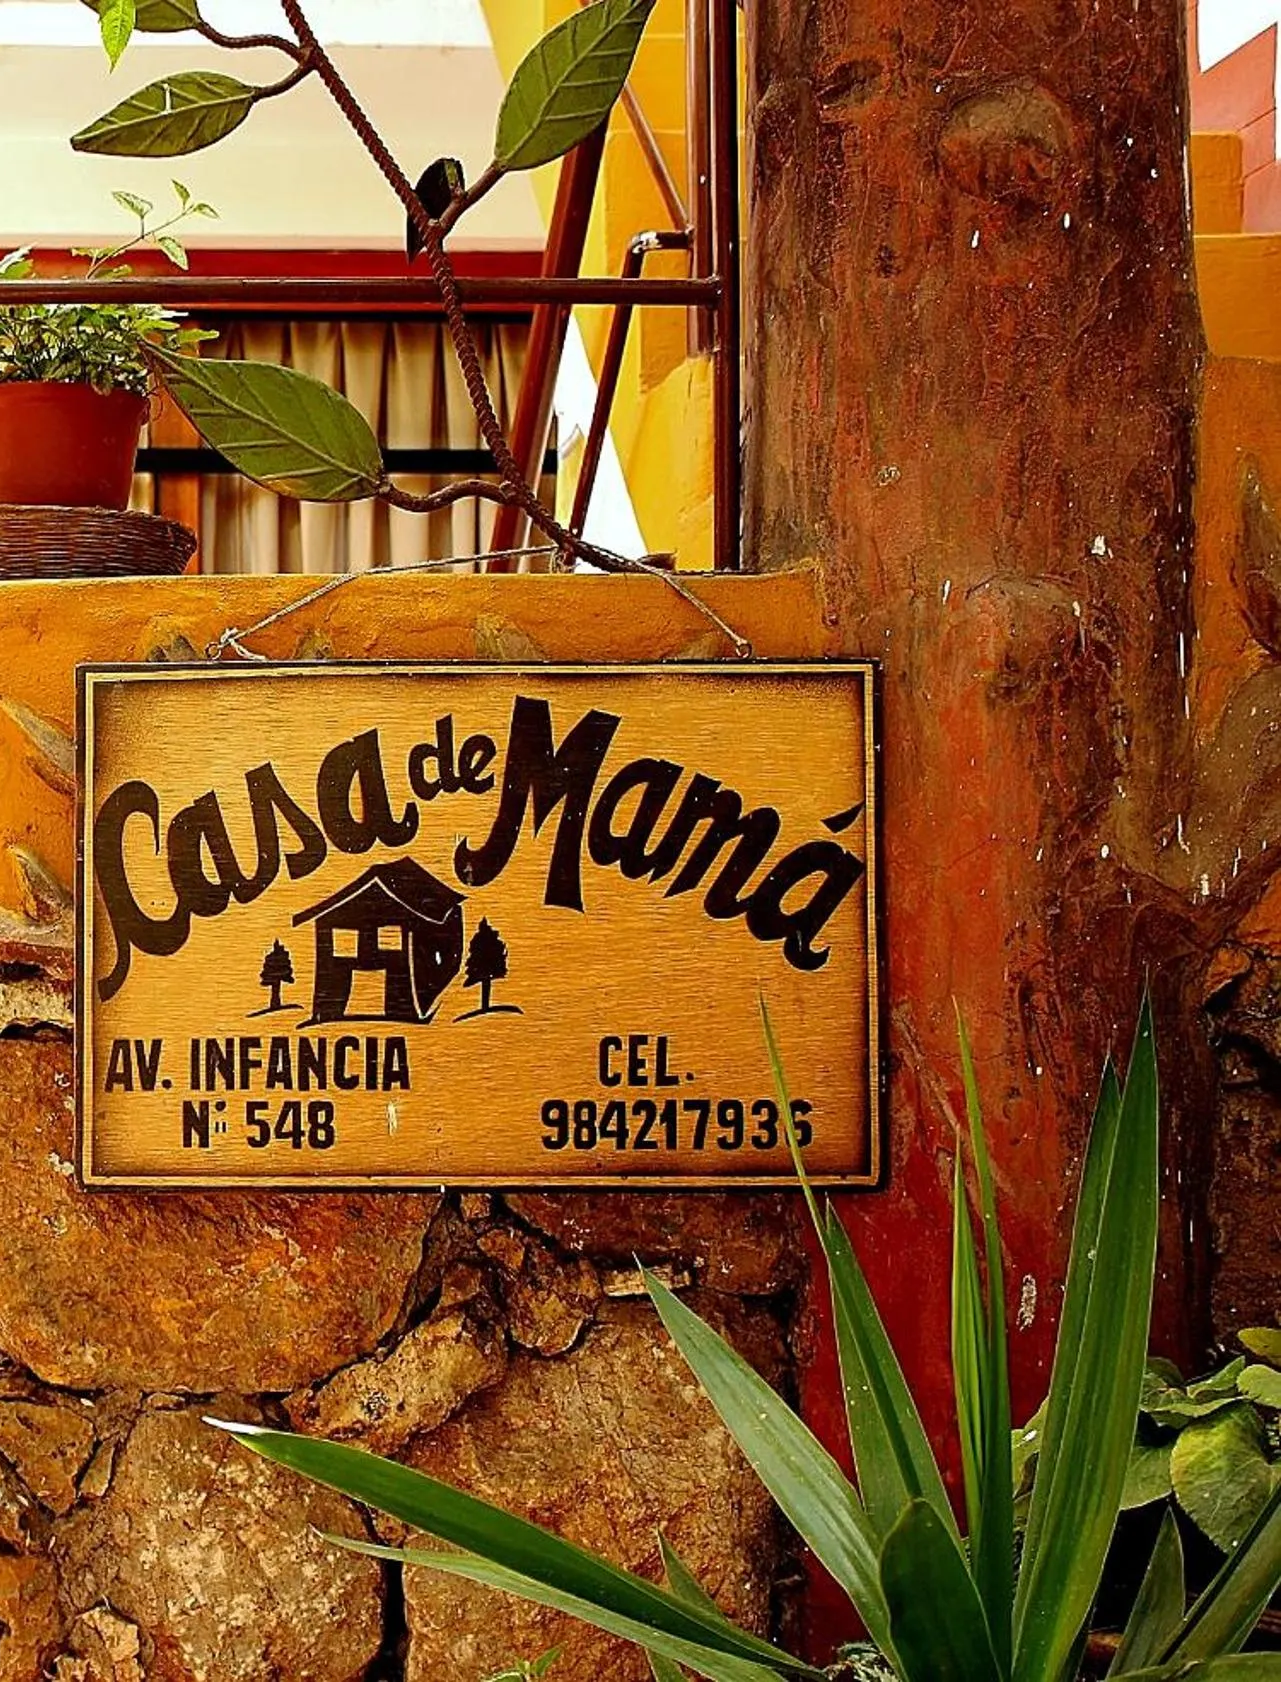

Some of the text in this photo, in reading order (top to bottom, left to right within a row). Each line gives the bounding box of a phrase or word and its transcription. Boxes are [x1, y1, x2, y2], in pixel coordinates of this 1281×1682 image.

[94, 694, 866, 1001] Casa de Mamá
[104, 1035, 412, 1093] AV. INFANCIA
[599, 1034, 695, 1088] CEL.
[245, 1100, 335, 1150] 548
